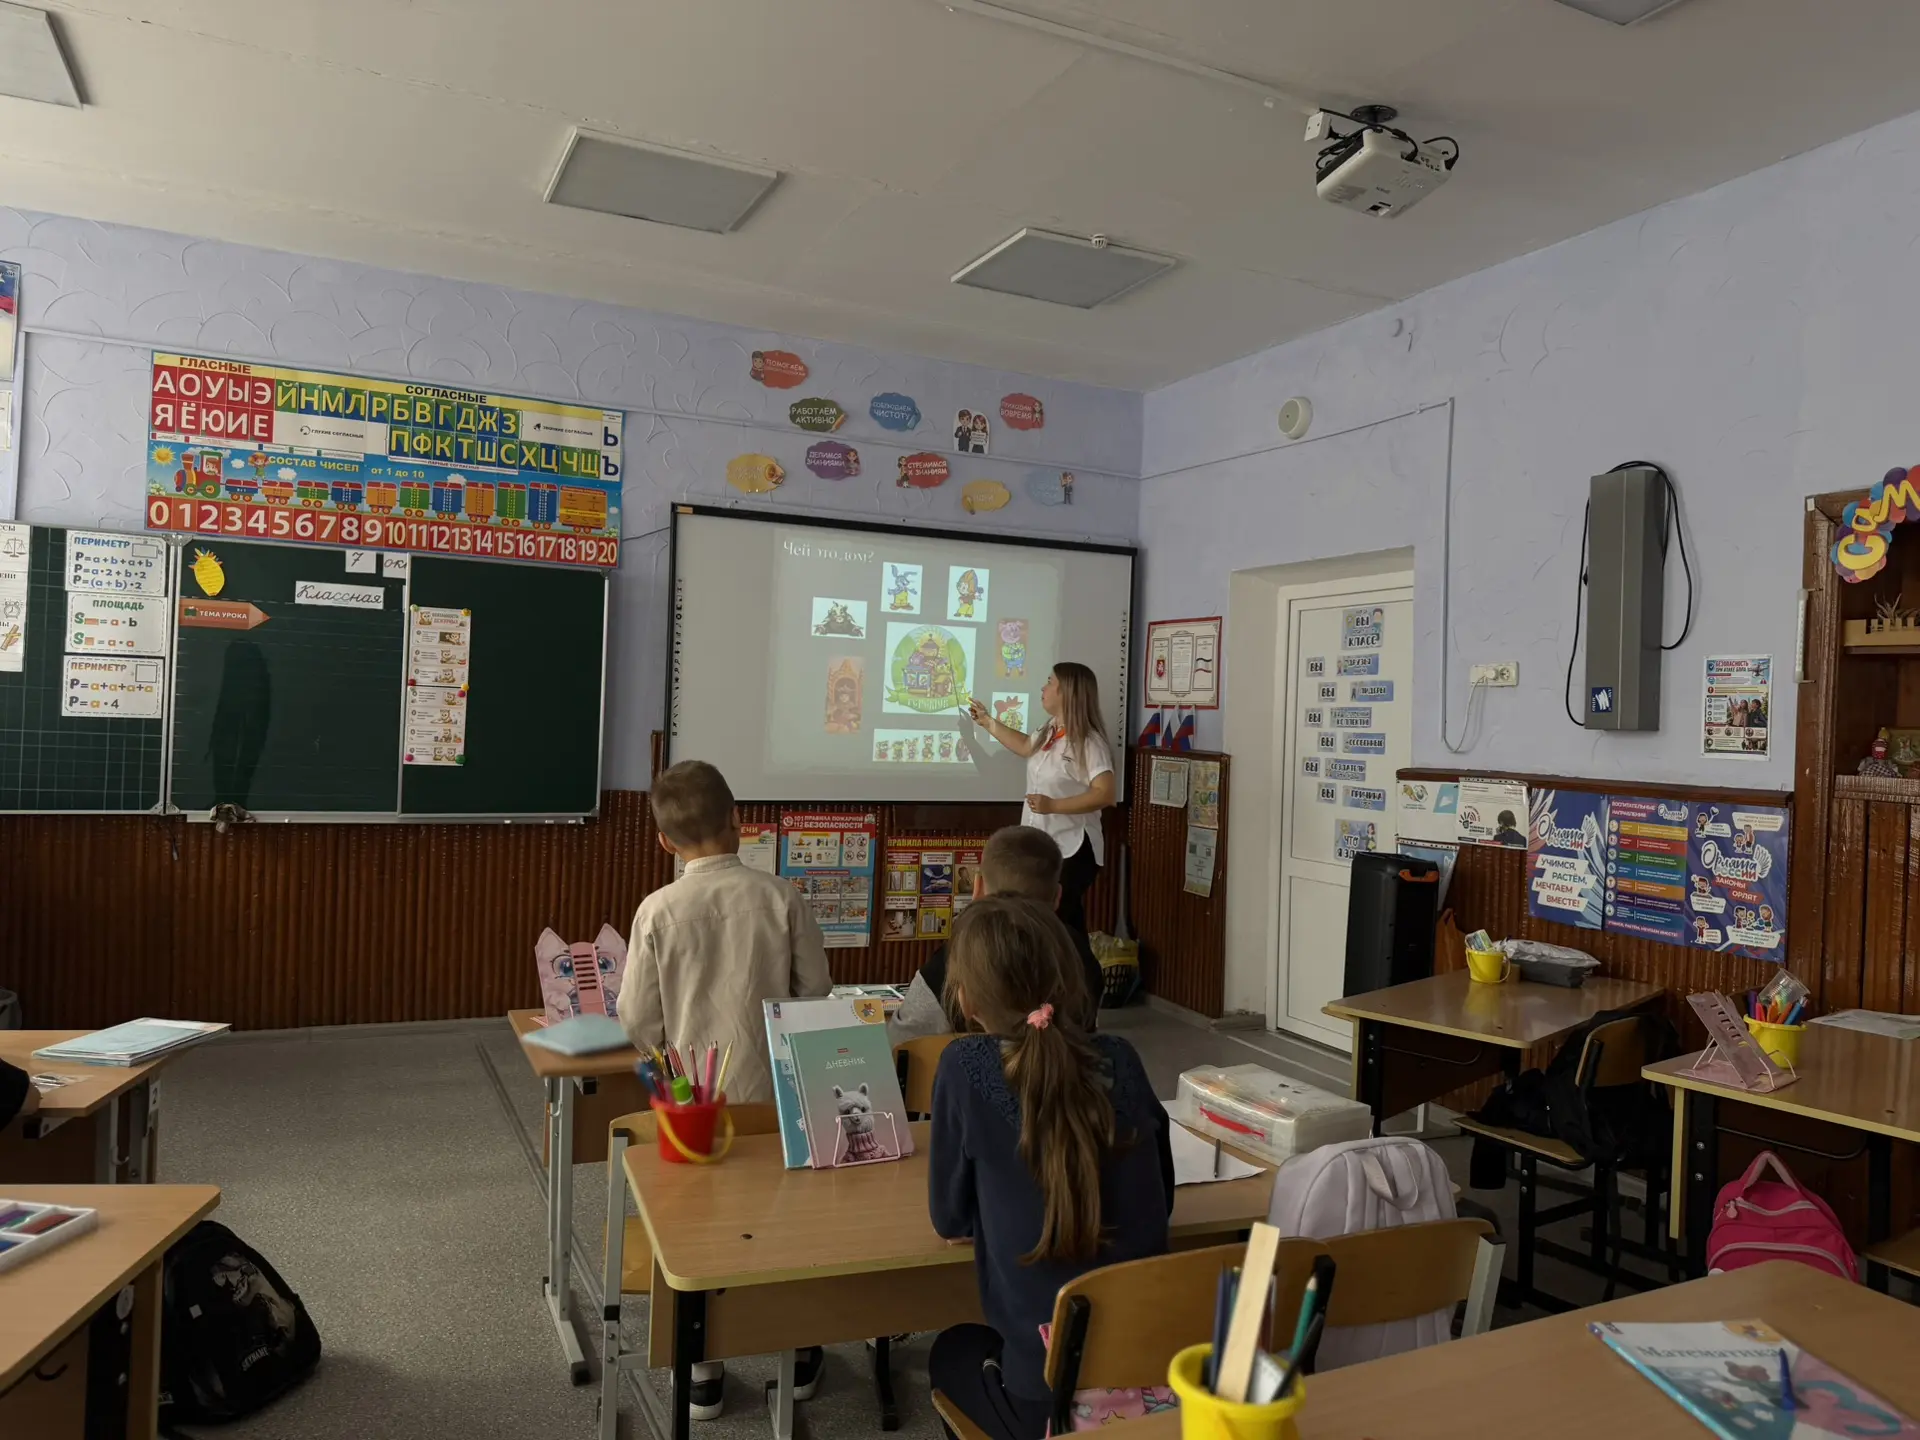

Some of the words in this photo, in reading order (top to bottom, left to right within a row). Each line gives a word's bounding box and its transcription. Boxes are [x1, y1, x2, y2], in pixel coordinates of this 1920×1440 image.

[179, 357, 252, 374] ГЛАСНЫЕ
[766, 359, 805, 371] ПОМОГАЕМ
[405, 385, 487, 404] СОГЛАСНЫЕ
[791, 407, 837, 415] РАБОТАЕМ
[874, 409, 910, 421] ЧИСТОТУ
[1000, 408, 1033, 421] ВОВРЕМЯ
[796, 416, 835, 424] АКТИВНО
[332, 431, 364, 439] СОГЛАСНЫЕ
[809, 451, 842, 460] ДЕЛИМСЯ
[268, 455, 316, 469] СОСТАВ
[320, 461, 360, 474] ЧИСЕЛ
[806, 458, 845, 467] ЗНАНИЯМИ
[908, 460, 947, 469] СТРЕМИМСЯ
[385, 467, 392, 476] 1
[395, 469, 409, 478] до
[412, 470, 425, 479] 10
[914, 468, 948, 476] ЗНАНИЯМ
[150, 501, 169, 526] 0
[178, 503, 191, 528] 1
[200, 504, 219, 530] 2
[224, 506, 242, 531] 3
[247, 509, 267, 534] 4
[272, 511, 290, 536] 5
[295, 513, 314, 537] 6
[319, 515, 337, 539] 7
[341, 516, 359, 541] 8
[364, 518, 382, 542] 9
[386, 521, 406, 545] 10
[408, 523, 427, 547] 11
[430, 525, 450, 549] 12
[451, 527, 471, 551] 13
[473, 529, 493, 553] 14
[495, 531, 514, 555] 15
[516, 533, 535, 556] 16
[536, 535, 556, 558] 17
[557, 536, 576, 560] 18
[577, 539, 596, 562] 19
[598, 541, 617, 563] 20
[74, 536, 130, 549] ПЕРИМЕТР
[783, 540, 811, 557] Чей
[351, 552, 364, 567] 7
[296, 584, 383, 604] Классная
[92, 600, 145, 611] ПЛОЩАДЬ
[199, 610, 221, 618] ТЕМА
[222, 611, 248, 620] УРОКА
[1348, 635, 1376, 647] КЛАСС
[70, 661, 127, 672] ПЕРИМЕТР
[740, 826, 758, 834] ЕЧИ
[804, 821, 863, 829] БЕЗОПАСНОСТИ
[1538, 814, 1585, 841] Орлята
[888, 838, 922, 847] ПРАВИЛА
[923, 838, 962, 847] ПОЖАРНОЙ
[1343, 835, 1359, 847] ЧТО
[1547, 836, 1584, 849] РОССИИ
[1703, 843, 1757, 872] Орлята
[1541, 858, 1577, 871] УЧИМСЯ,
[1715, 866, 1757, 880] РОССИИ
[1536, 881, 1573, 894] МЕЧТАЕМ
[1715, 876, 1746, 888] ЗАКОНЫ
[1546, 895, 1581, 907] ВМЕСТЕ!
[1732, 890, 1758, 901] ОРЛЯТ
[824, 1056, 866, 1070] ДНЕВНИК
[152, 1090, 159, 1105] 2
[1638, 1345, 1779, 1359] Математика
